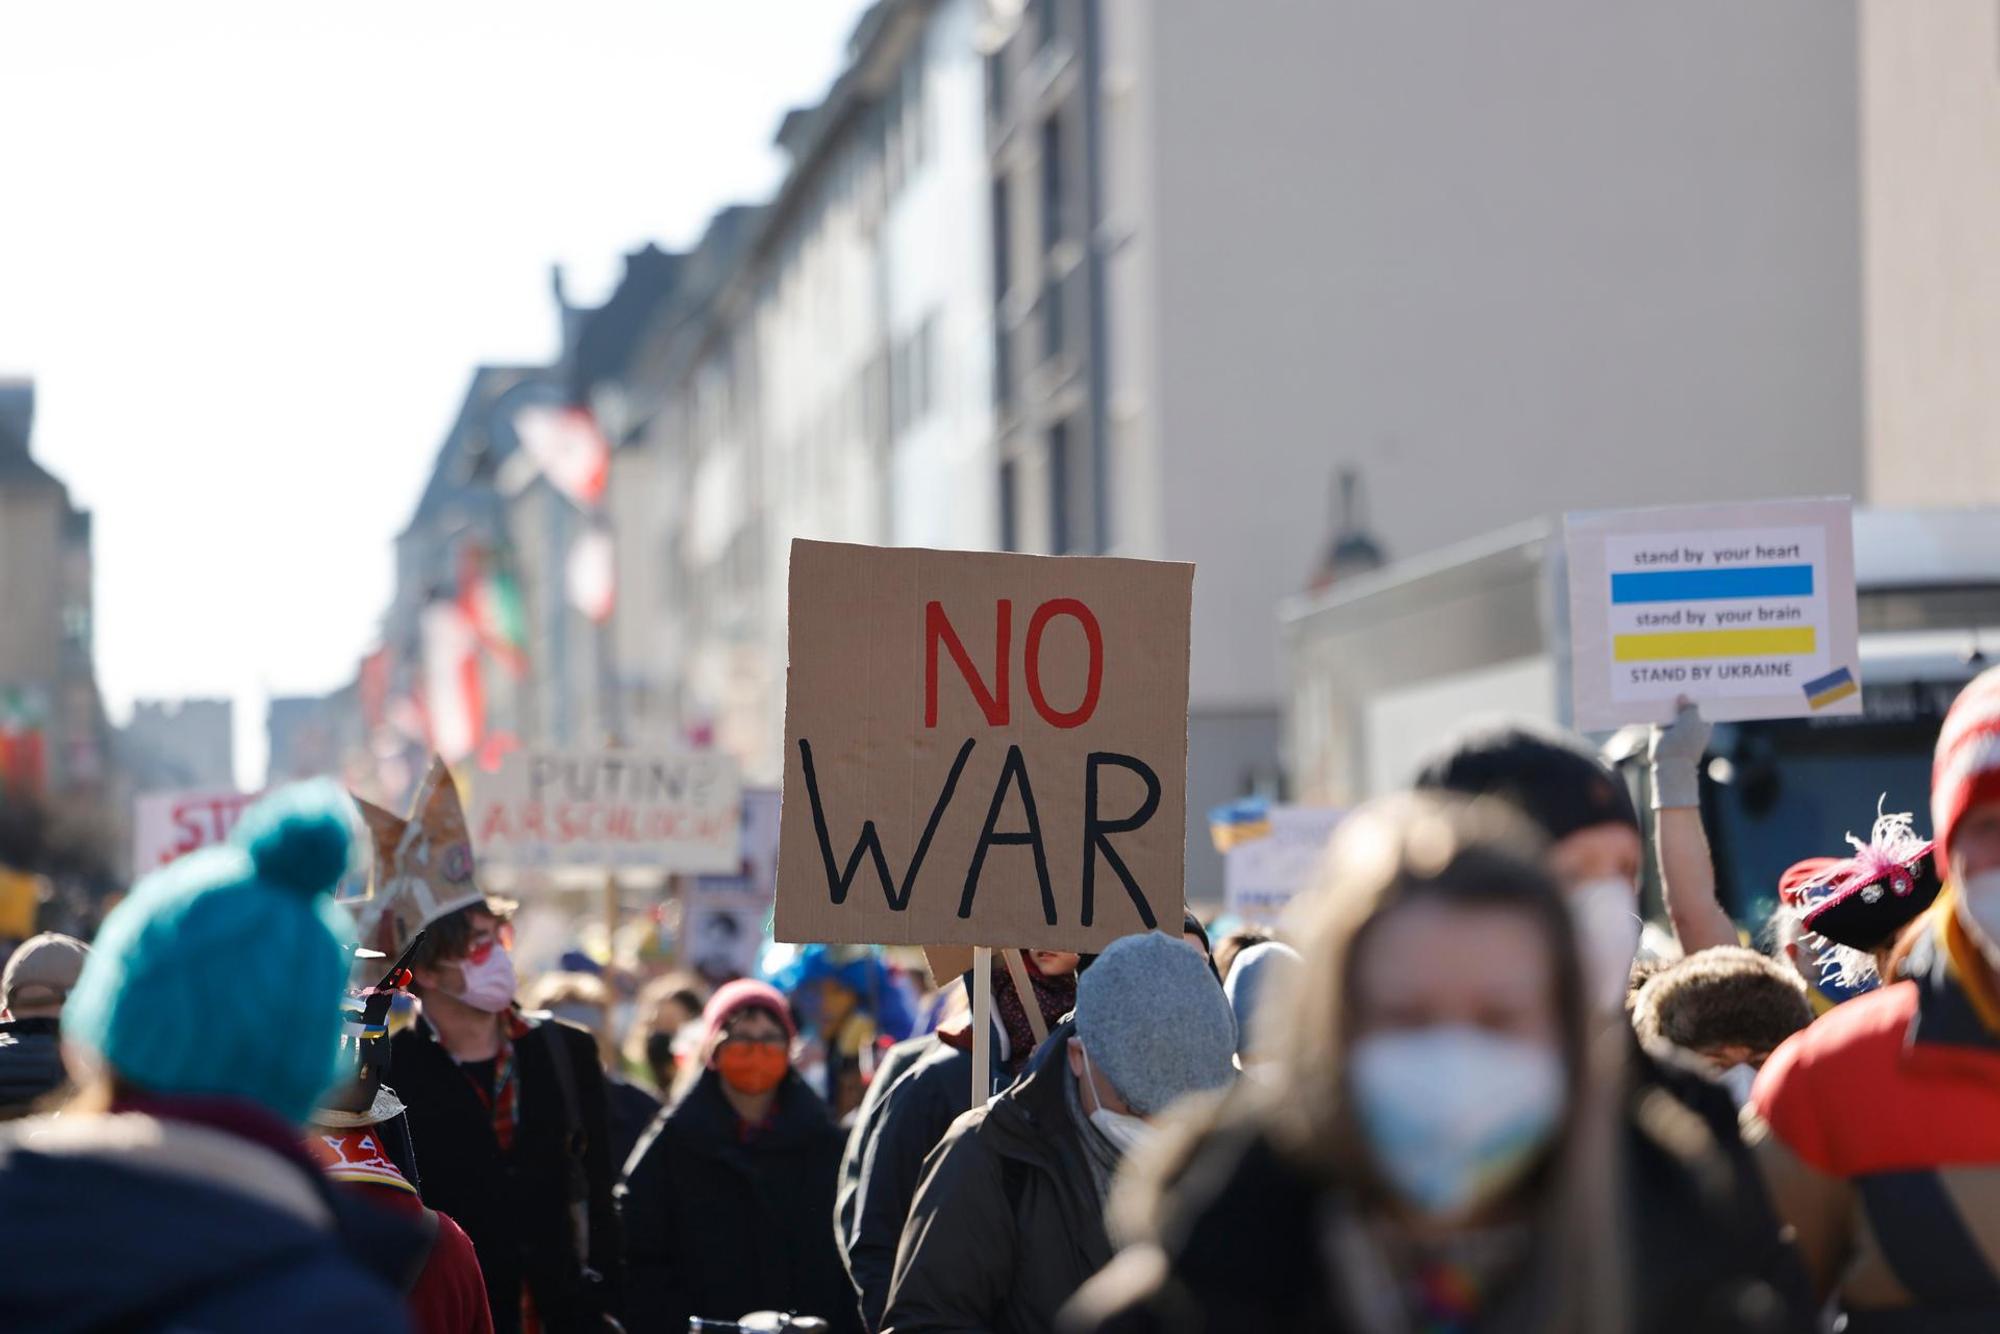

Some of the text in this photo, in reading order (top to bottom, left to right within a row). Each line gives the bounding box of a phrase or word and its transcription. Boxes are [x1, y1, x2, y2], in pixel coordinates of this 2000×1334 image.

[1634, 545, 1800, 565] stand by your heart
[1636, 605, 1801, 626] stand by your brain
[925, 598, 1104, 729] NO
[1631, 662, 1792, 683] STAND BY UKRAINE
[798, 738, 1161, 929] WAR
